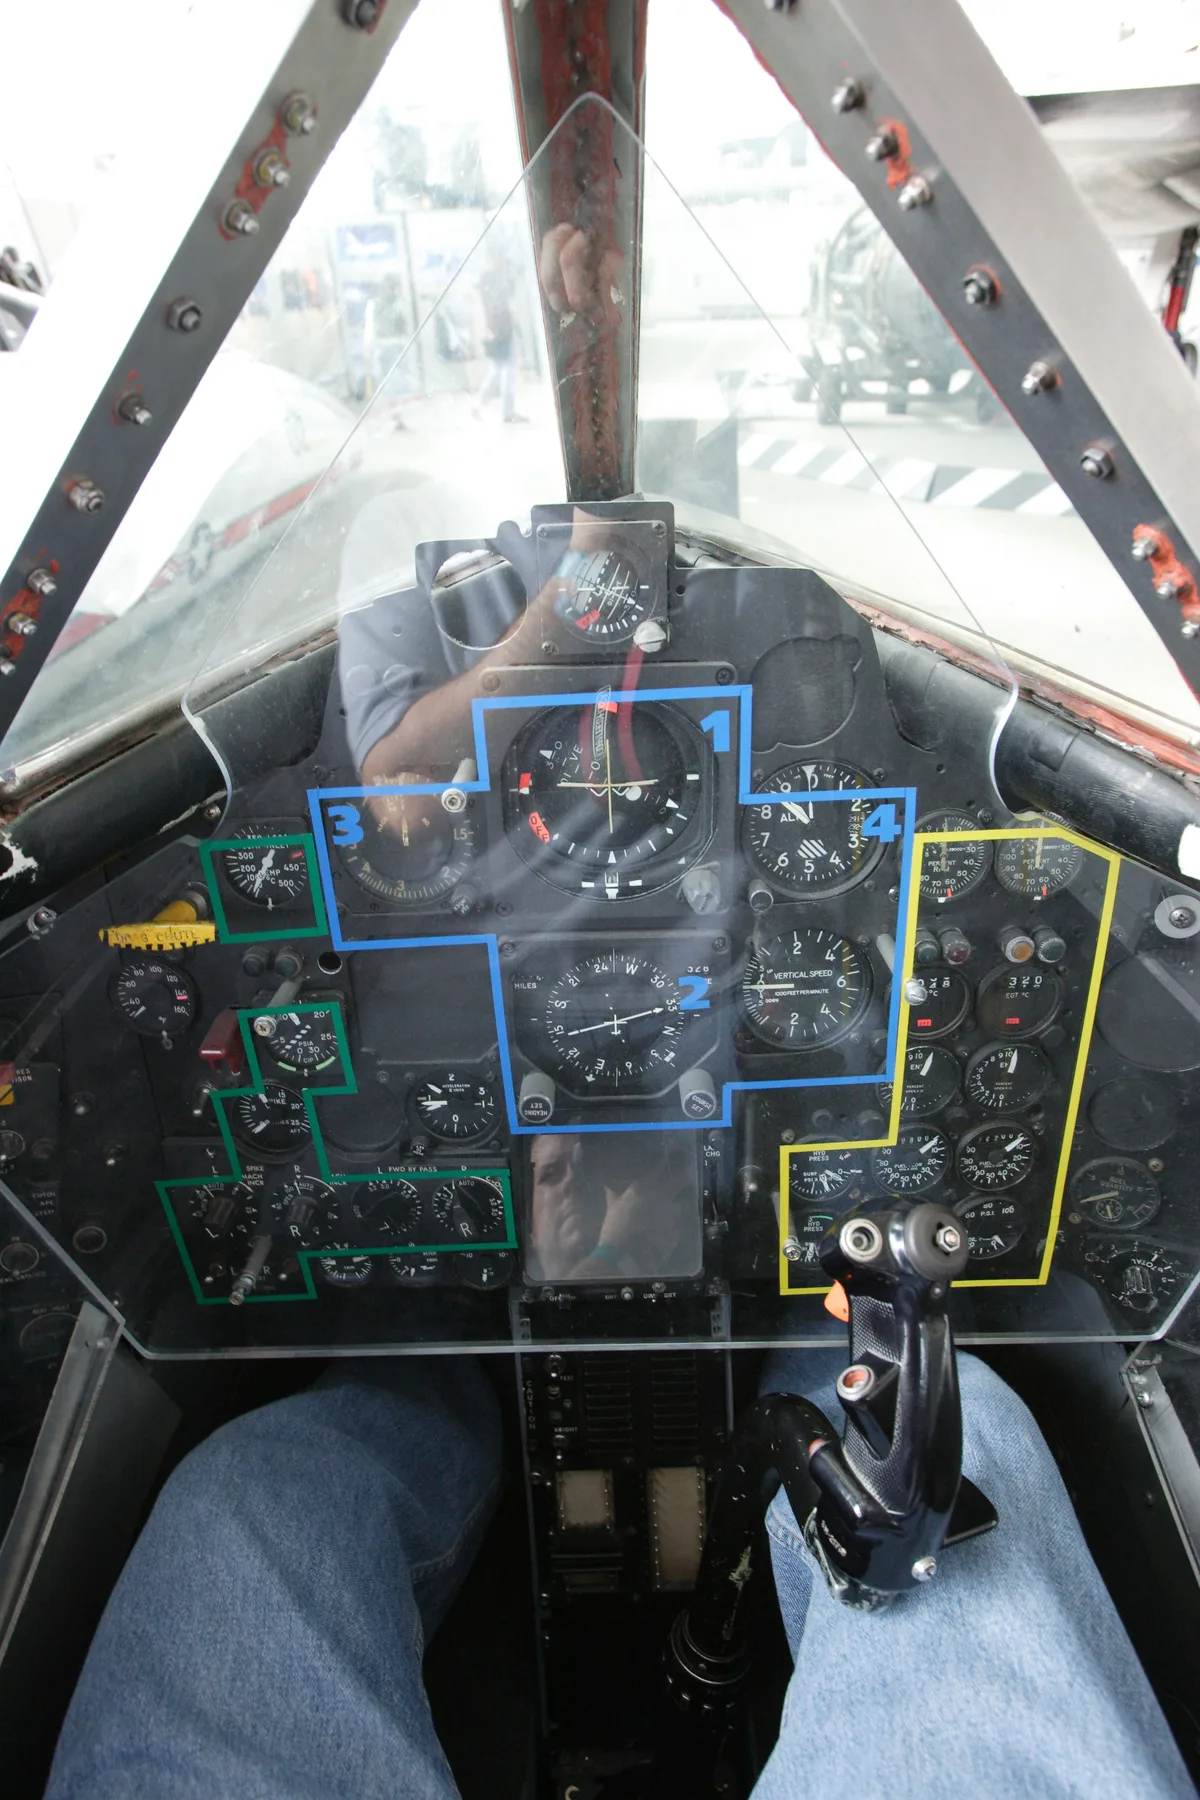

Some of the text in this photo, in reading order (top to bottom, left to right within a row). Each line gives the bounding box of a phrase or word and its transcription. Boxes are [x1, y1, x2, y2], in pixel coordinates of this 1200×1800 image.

[700, 711, 729, 752] 1
[850, 798, 862, 812] 2
[760, 804, 772, 820] 8
[328, 805, 364, 846] 3
[530, 815, 549, 843] OFF
[862, 804, 901, 842] 4
[760, 832, 771, 847] 7
[848, 834, 860, 848] 3
[238, 852, 254, 860] 300
[777, 852, 789, 867] 6
[829, 850, 842, 865] 4
[1002, 853, 1017, 861] 100
[240, 865, 256, 873] 200
[283, 863, 300, 872] 450
[804, 860, 815, 873] 5
[792, 941, 802, 955] 2
[825, 949, 836, 962] 4
[133, 968, 144, 976] 80
[593, 962, 609, 974] 24
[625, 962, 639, 975] W
[166, 975, 179, 983] 120
[773, 969, 833, 980] VERTICAL SPEED
[125, 980, 137, 988] 60
[650, 975, 665, 988] 30
[836, 975, 847, 988] 6
[678, 975, 710, 1010] 2
[129, 997, 141, 1005] 40
[554, 999, 568, 1009] S
[666, 998, 677, 1012] 33
[174, 1005, 186, 1014] 160
[820, 1003, 831, 1015] 4
[790, 1012, 799, 1025] 2
[662, 1025, 676, 1036] N
[308, 1046, 320, 1054] 30
[908, 1053, 914, 1061] 9
[910, 1063, 922, 1071] EN
[448, 1073, 455, 1081] 2
[975, 1073, 981, 1081] 5
[478, 1086, 486, 1095] 3
[691, 1094, 713, 1110] COURSE
[691, 1103, 704, 1113] SET
[452, 1114, 459, 1122] 0
[294, 1165, 301, 1173] R
[378, 1166, 383, 1174] L
[997, 1168, 1008, 1176] 40
[1100, 1180, 1134, 1193] QUANTITY
[290, 1225, 301, 1237] R
[460, 1222, 473, 1237] R
[263, 1266, 271, 1275] R
[526, 1380, 536, 1430] CAUTION
[554, 1426, 578, 1434] BRIGHT
